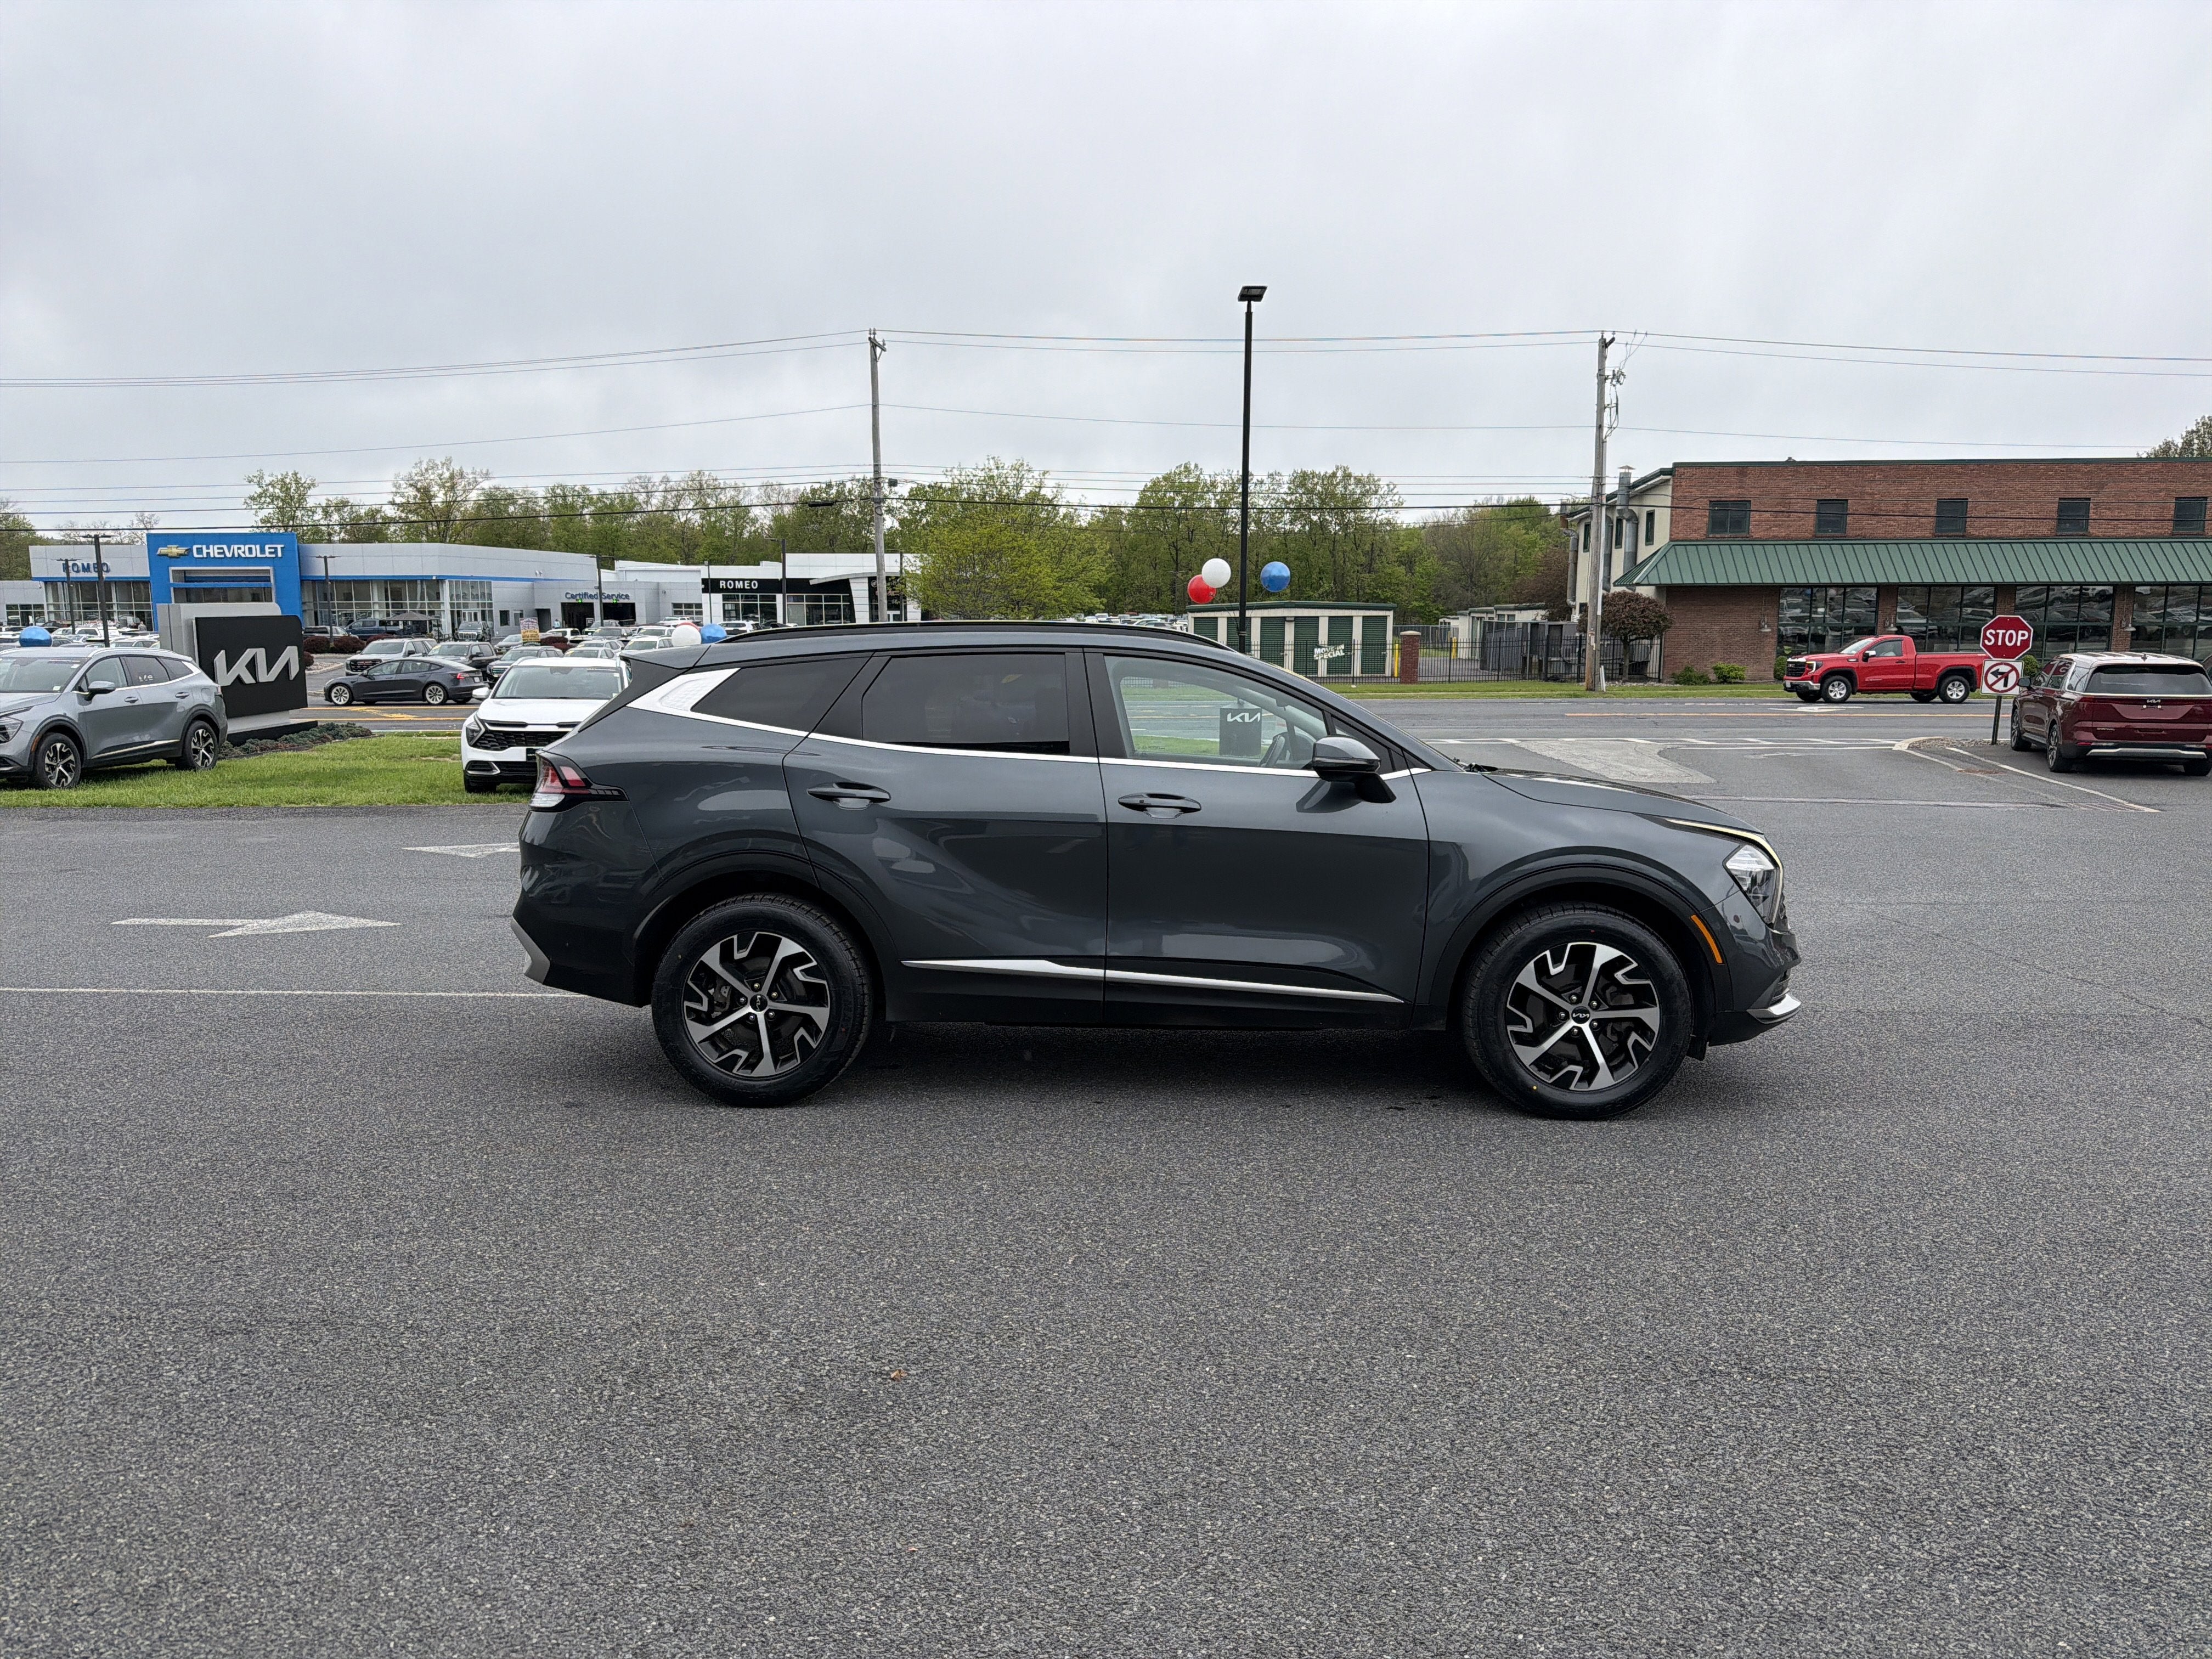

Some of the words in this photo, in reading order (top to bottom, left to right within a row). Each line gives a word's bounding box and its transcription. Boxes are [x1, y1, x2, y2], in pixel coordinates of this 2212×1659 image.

[193, 544, 284, 558] CHEVROLET
[719, 580, 758, 589] ROMEO
[1984, 629, 2029, 646] STOP
[1313, 649, 1345, 660] SPECIAL
[1314, 644, 1345, 654] MOVE-IN
[214, 646, 299, 686] KIA
[1227, 712, 1261, 723] KIA
